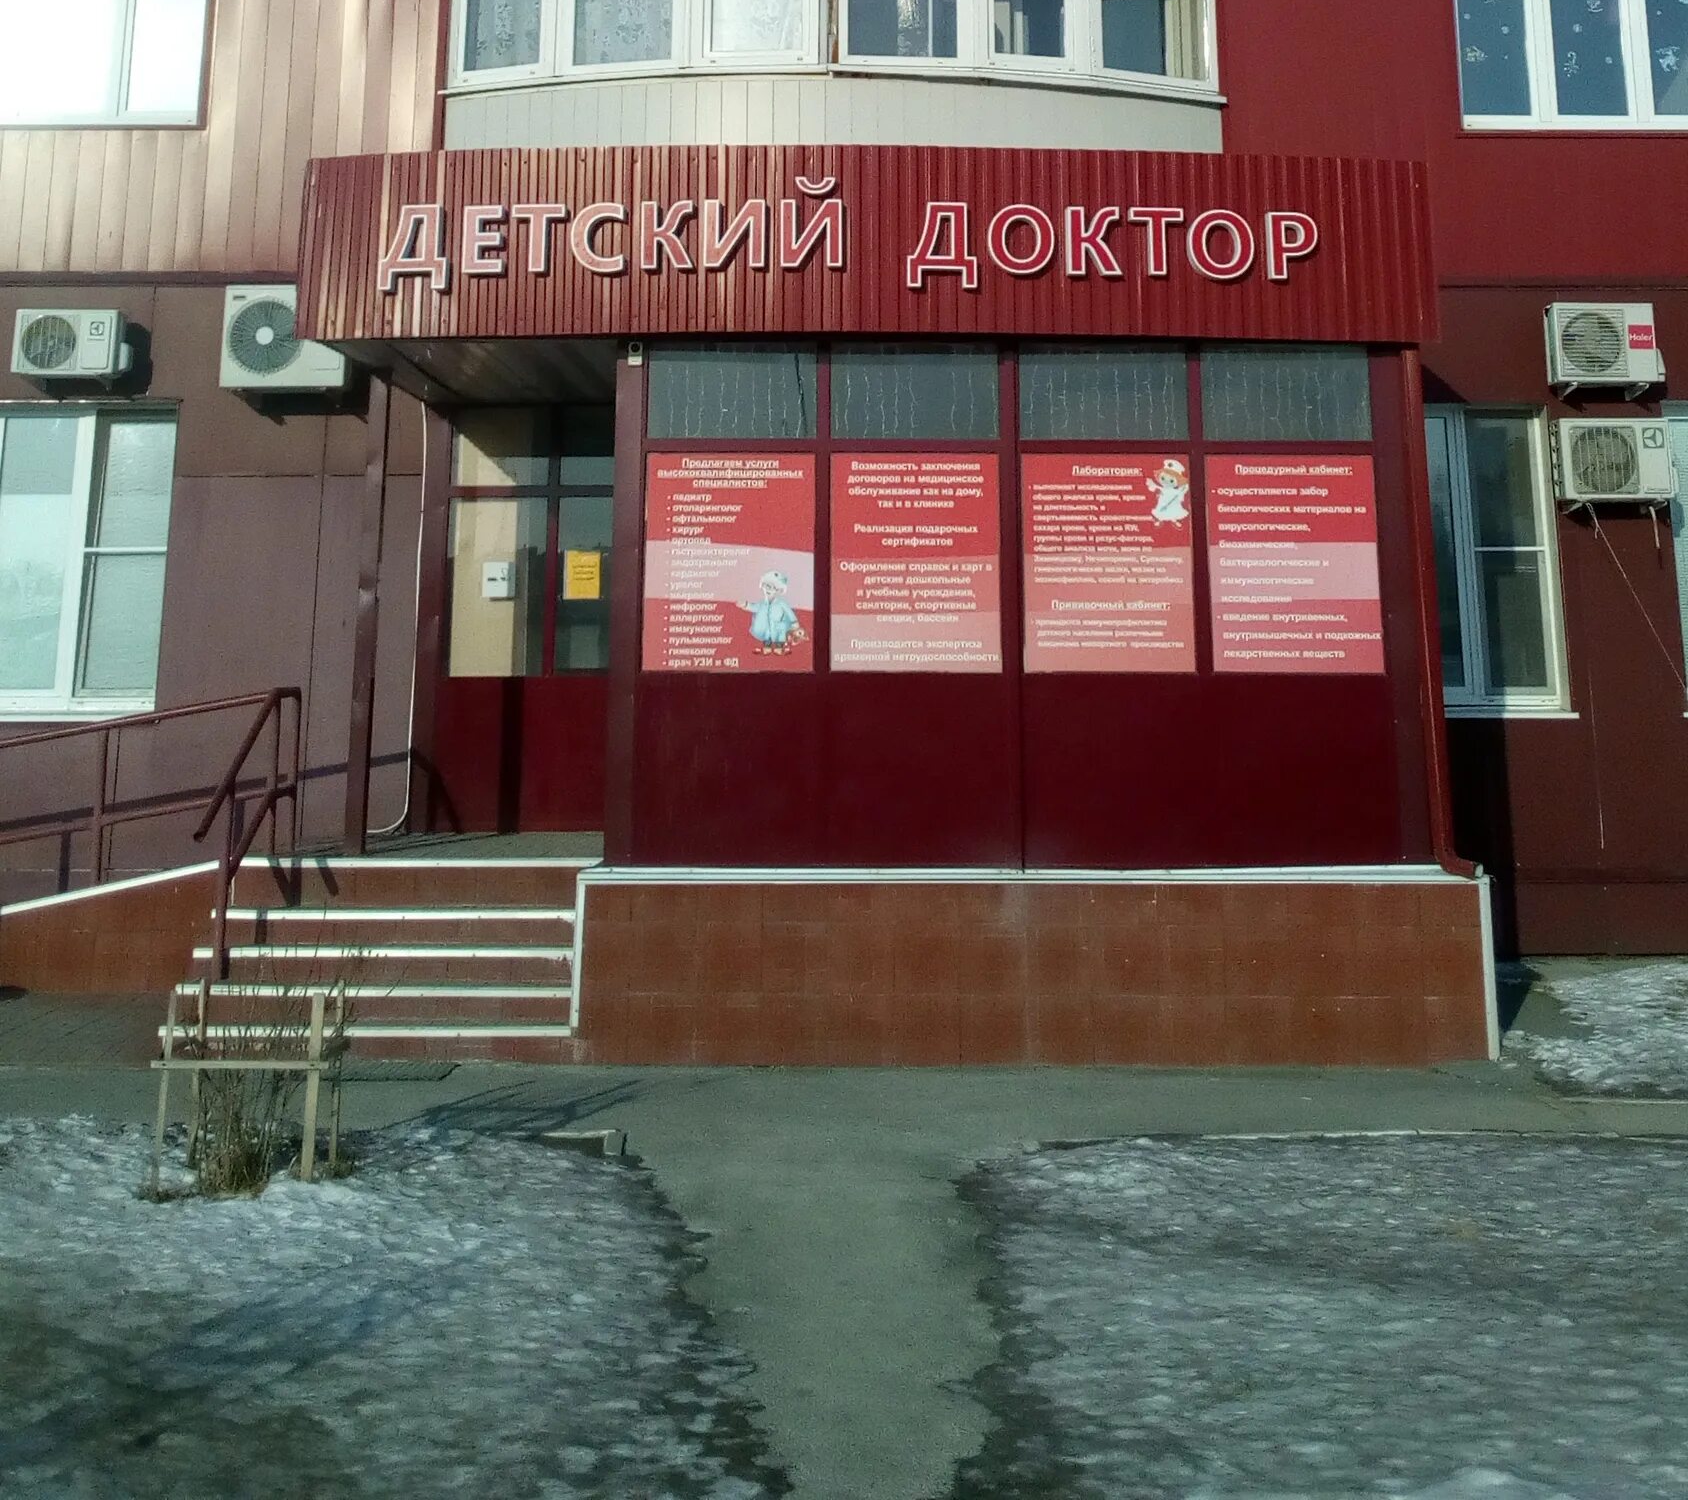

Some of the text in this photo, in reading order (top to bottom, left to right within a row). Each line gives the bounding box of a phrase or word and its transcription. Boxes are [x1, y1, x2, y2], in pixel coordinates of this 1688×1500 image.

[378, 176, 1320, 293] ДЕТСКИЙ ДОКТОР
[1630, 333, 1653, 341] Haier
[682, 458, 779, 468] Предлагаем услуги
[852, 461, 980, 471] Возможность заключения
[658, 469, 803, 478] высококвалифицированных
[1072, 466, 1143, 476] Лаборатория:
[1236, 465, 1352, 475] Процедурный кабинет:
[693, 479, 767, 488] специалистов:
[848, 475, 900, 484] договоров
[918, 476, 983, 484] медицинское
[848, 487, 921, 496] обслуживание
[956, 489, 983, 497] дому,
[1217, 488, 1328, 496] осуществляется забор
[1217, 505, 1290, 513] биологических
[1293, 506, 1352, 514] материалов
[672, 515, 736, 523] офтальмолог
[854, 524, 913, 533] Реализация
[1219, 523, 1311, 532] вирусологические,
[882, 538, 953, 547] сертификатов
[840, 562, 906, 572] Оформление
[909, 563, 949, 572] справок
[961, 563, 983, 572] карт
[864, 576, 971, 585] детские дошкольные
[866, 587, 909, 598] учебные
[912, 589, 975, 598] учреждения,
[670, 603, 717, 611] нефролог
[856, 602, 976, 611] санатории, спортивные
[1052, 600, 1124, 610] Прививочный
[670, 615, 724, 623] аллерголог
[877, 613, 959, 623] секции, бассейн
[1273, 614, 1348, 622] внутривенных,
[669, 626, 722, 634] иммунолог
[1223, 632, 1312, 640] внутримышечных
[669, 637, 733, 645] пульмонолог
[851, 639, 923, 648] Производится
[834, 652, 999, 662] временной нетрудоспособности
[1224, 651, 1345, 659] лекарственных веществ
[669, 660, 690, 668] врач
[694, 658, 713, 666] УЗИ
[724, 658, 739, 667] ФД
